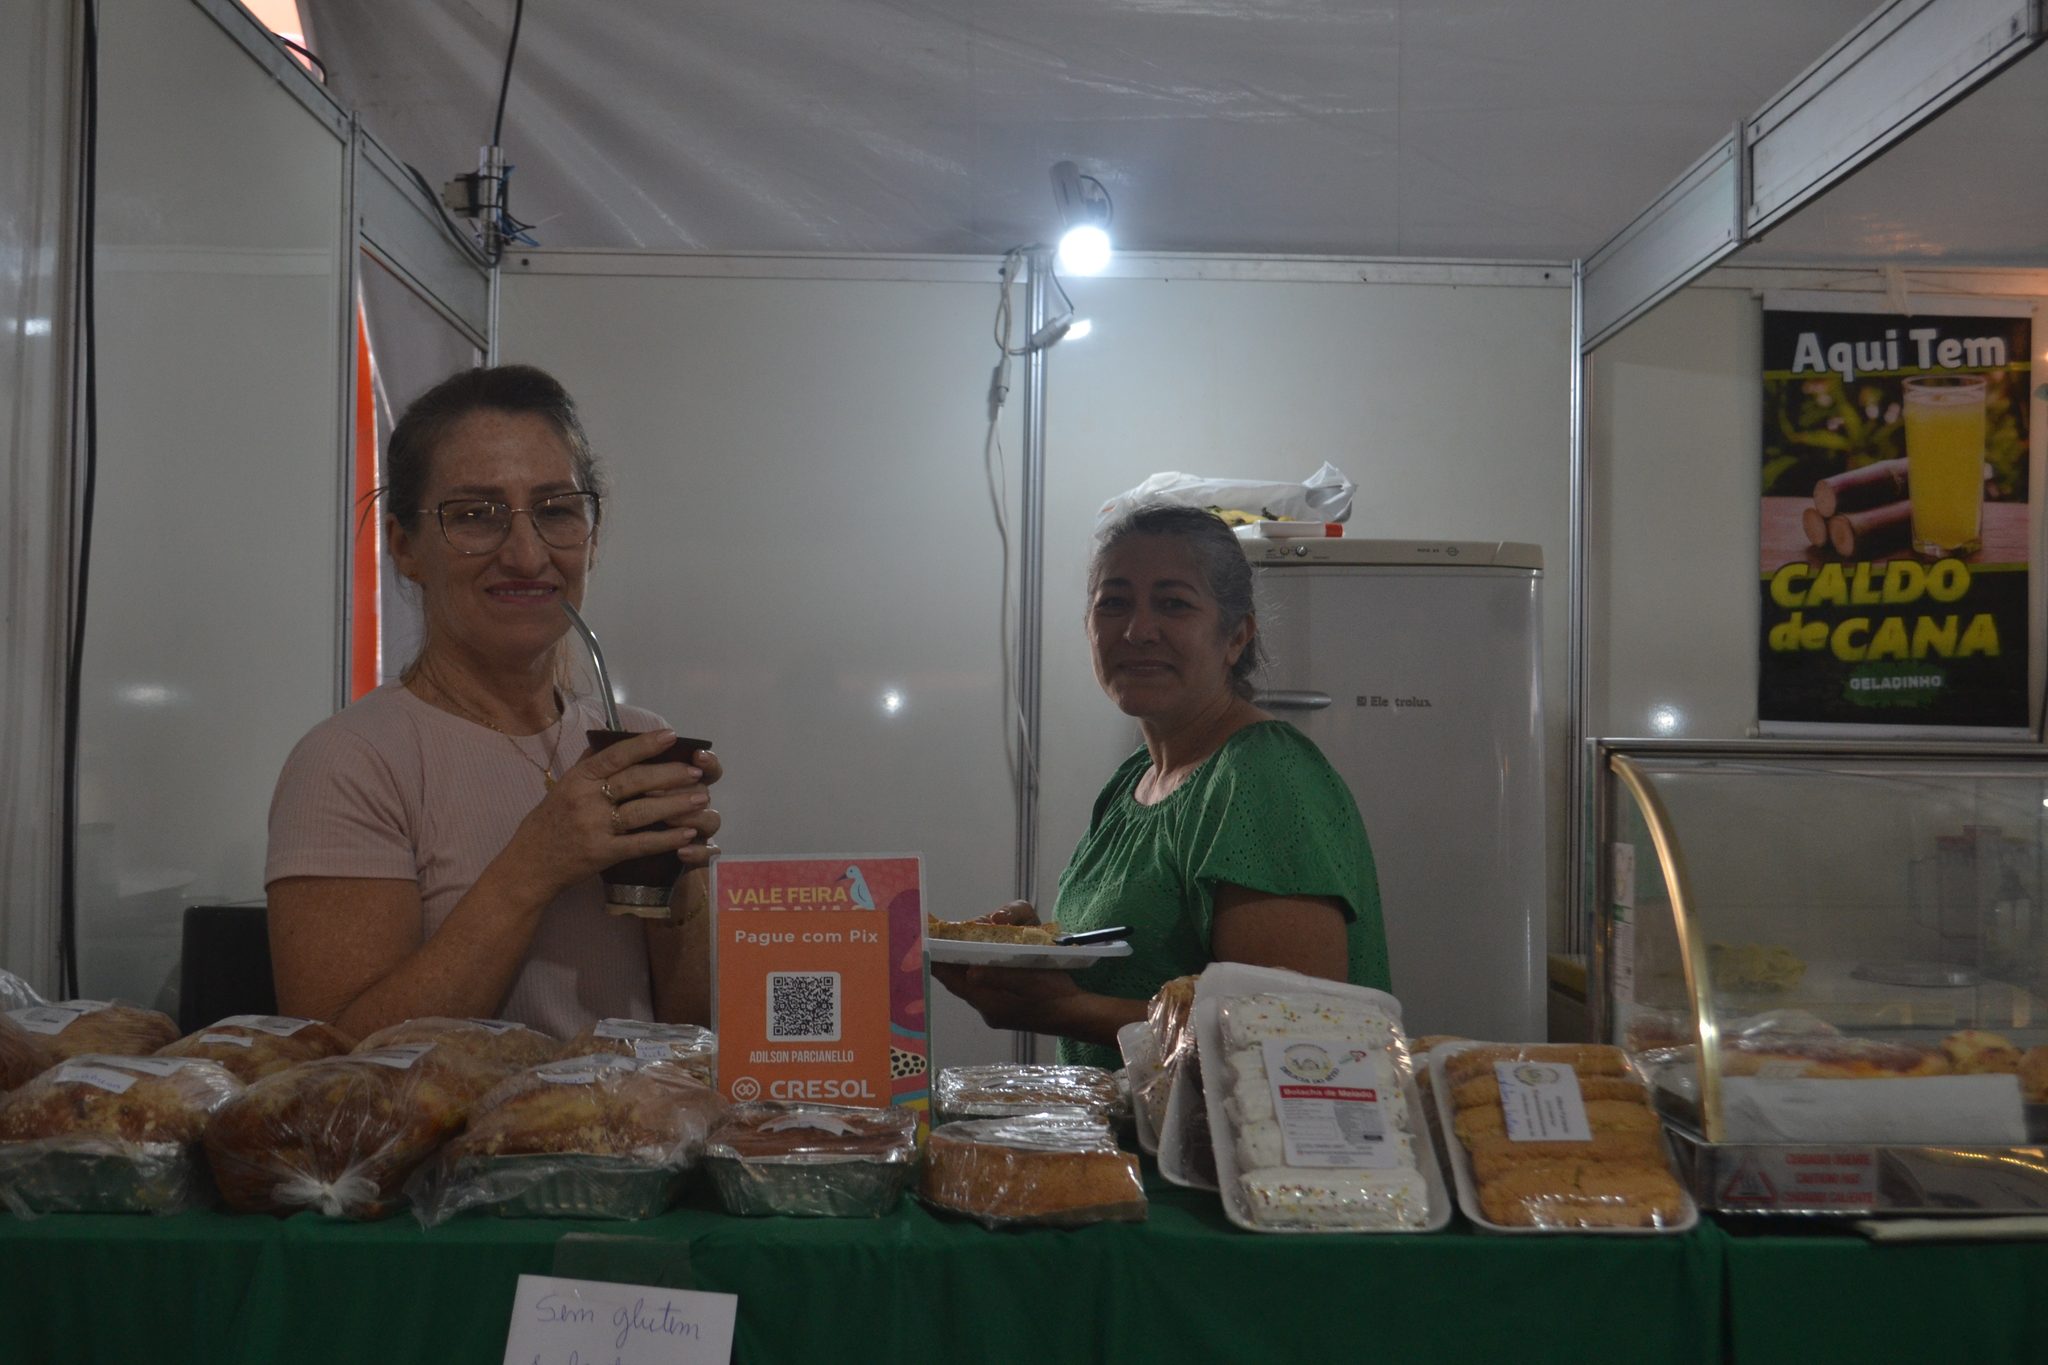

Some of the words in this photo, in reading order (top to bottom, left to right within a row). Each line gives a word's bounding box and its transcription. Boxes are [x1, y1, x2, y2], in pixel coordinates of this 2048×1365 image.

[1792, 330, 1899, 382] Aqui
[1910, 328, 2007, 369] Tem
[1769, 557, 1971, 608] CALDO
[1769, 611, 1829, 652] de
[1830, 613, 2002, 662] CANA
[1849, 675, 1943, 690] GELADINHO
[728, 887, 783, 905] VALE
[787, 886, 848, 904] FEIRA
[735, 930, 795, 946] Pague
[802, 931, 842, 943] com
[849, 929, 878, 943] Pix
[749, 1051, 790, 1064] ADILSON
[791, 1050, 854, 1063] PARCIANELLO
[770, 1080, 876, 1099] CRESOL
[536, 1293, 594, 1323] Sem
